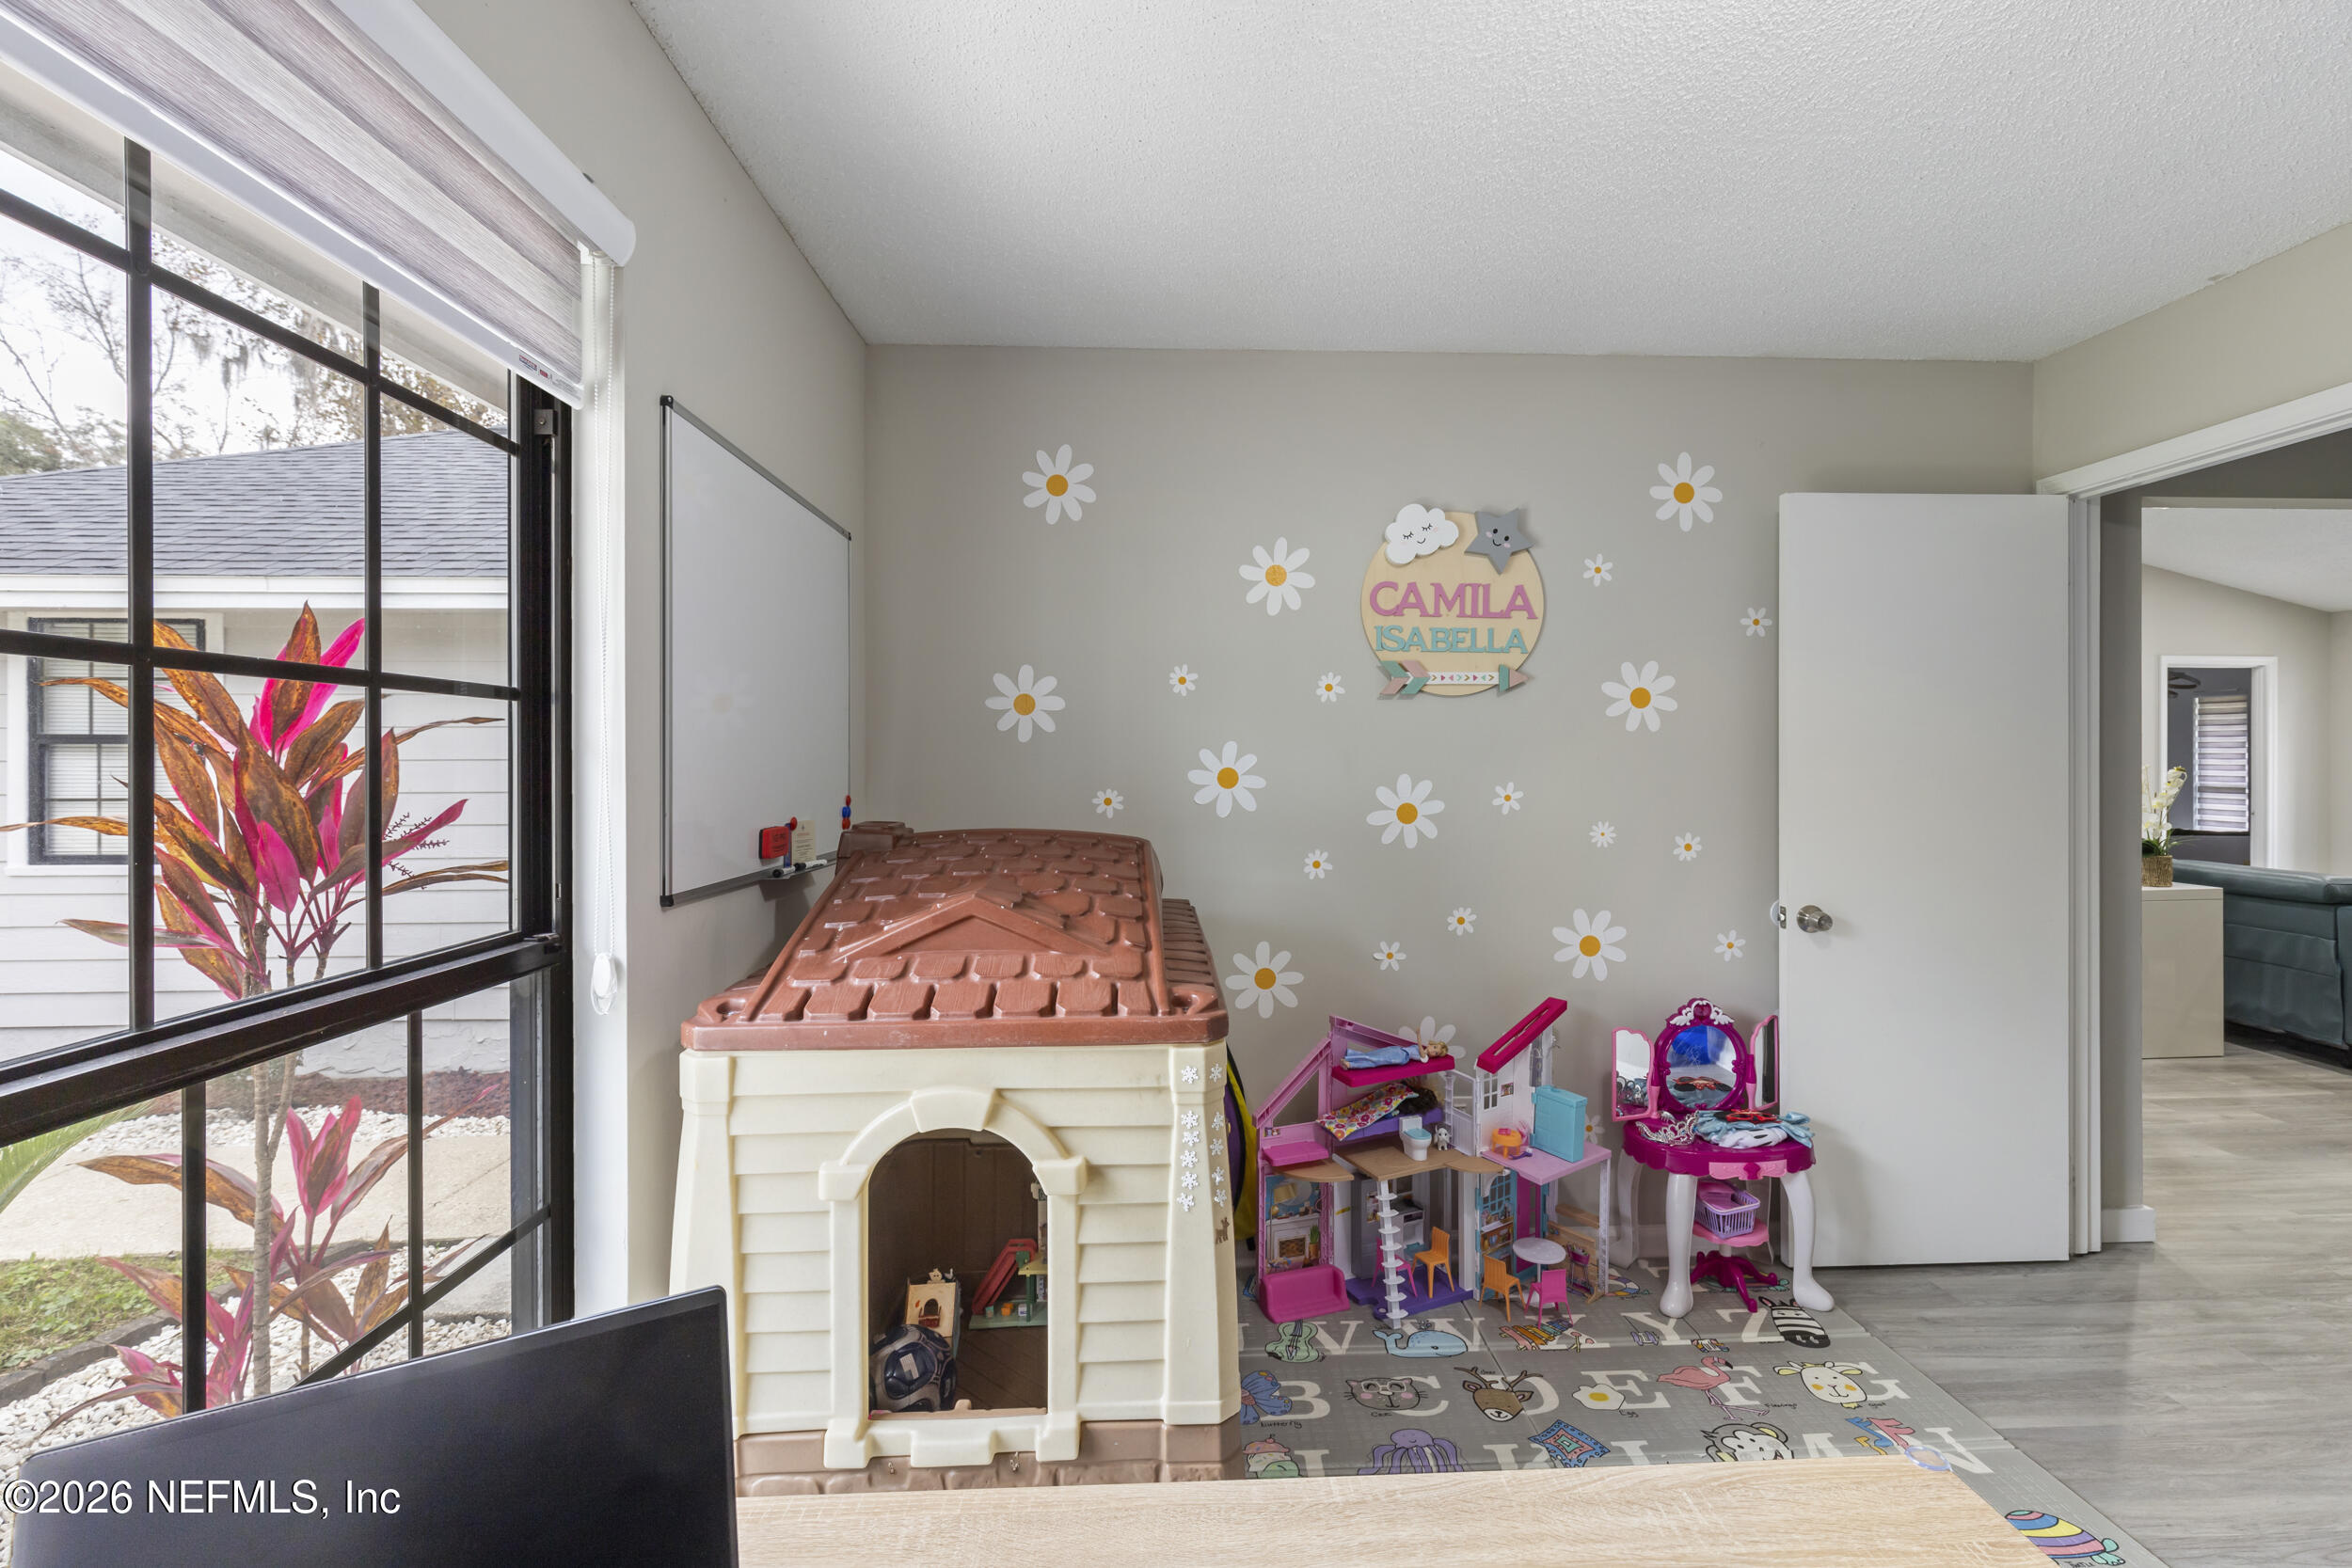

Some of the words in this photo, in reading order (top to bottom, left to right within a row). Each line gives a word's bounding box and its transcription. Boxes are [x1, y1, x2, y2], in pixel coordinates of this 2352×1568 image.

[1370, 581, 1538, 620] CAMILA
[1375, 626, 1528, 654] ISABELLA
[1313, 1321, 1363, 1355] V
[1620, 1311, 1692, 1346] Y
[1715, 1308, 1786, 1343] Z
[1581, 1370, 1671, 1409] E
[1712, 1366, 1762, 1406] F
